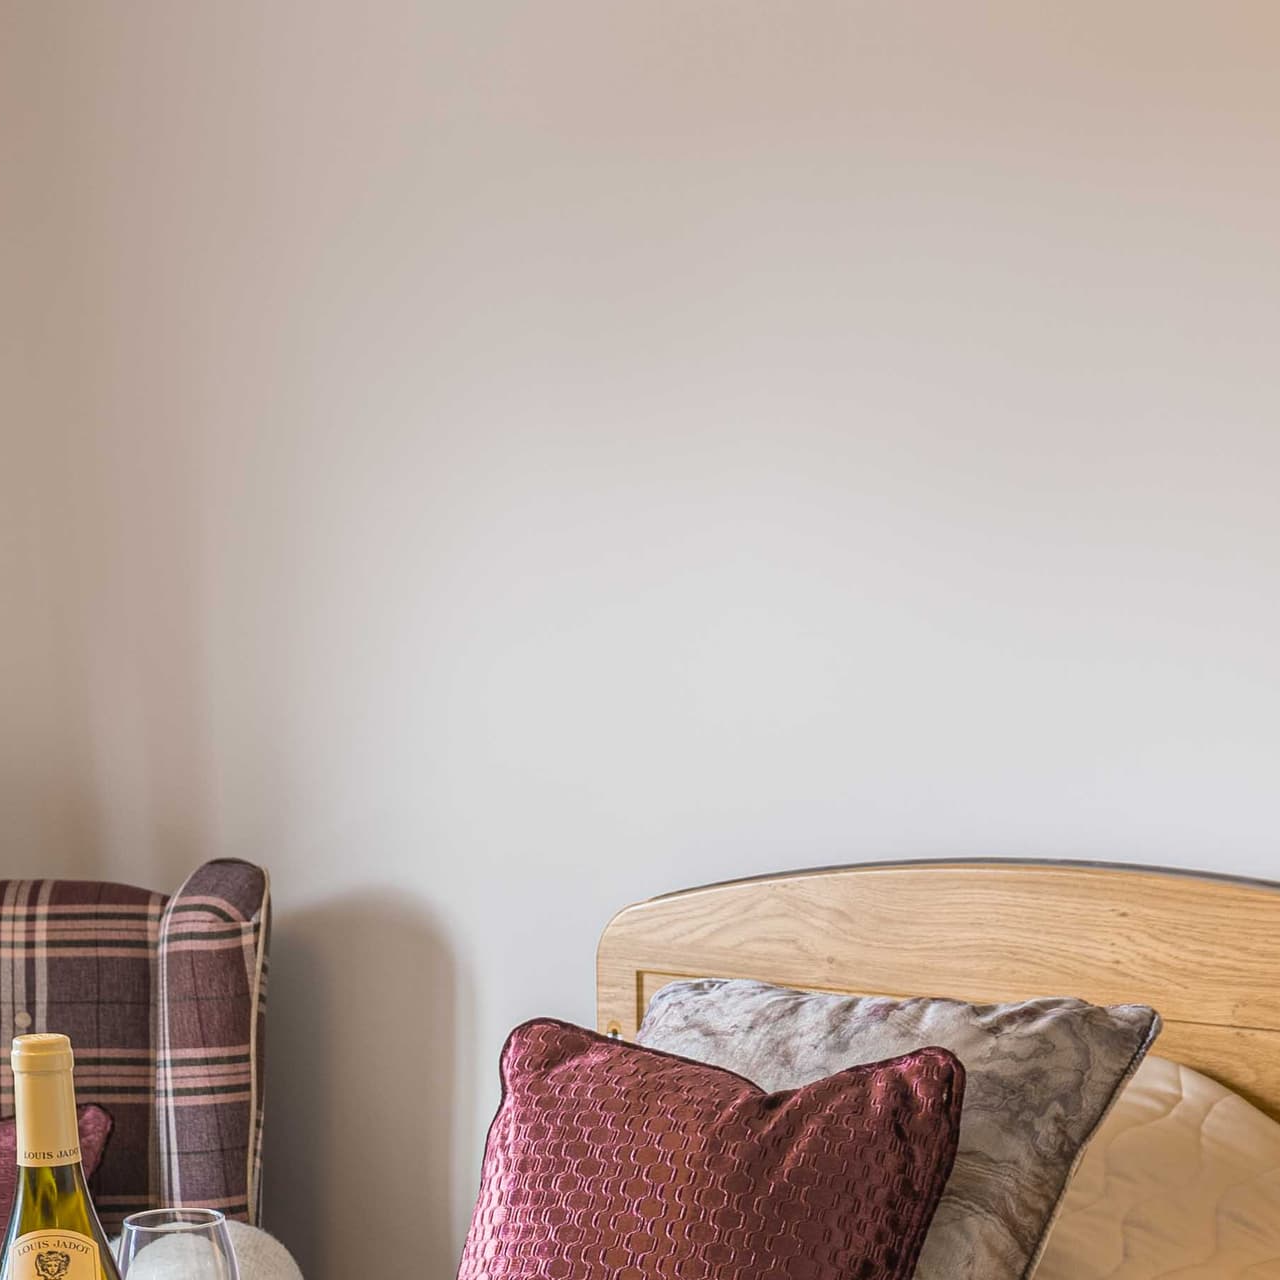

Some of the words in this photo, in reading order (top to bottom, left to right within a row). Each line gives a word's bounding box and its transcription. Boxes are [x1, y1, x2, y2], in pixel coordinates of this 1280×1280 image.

[24, 1151, 54, 1160] LOUIS
[17, 1240, 50, 1257] LOUIS
[53, 1240, 91, 1255] JADOT
